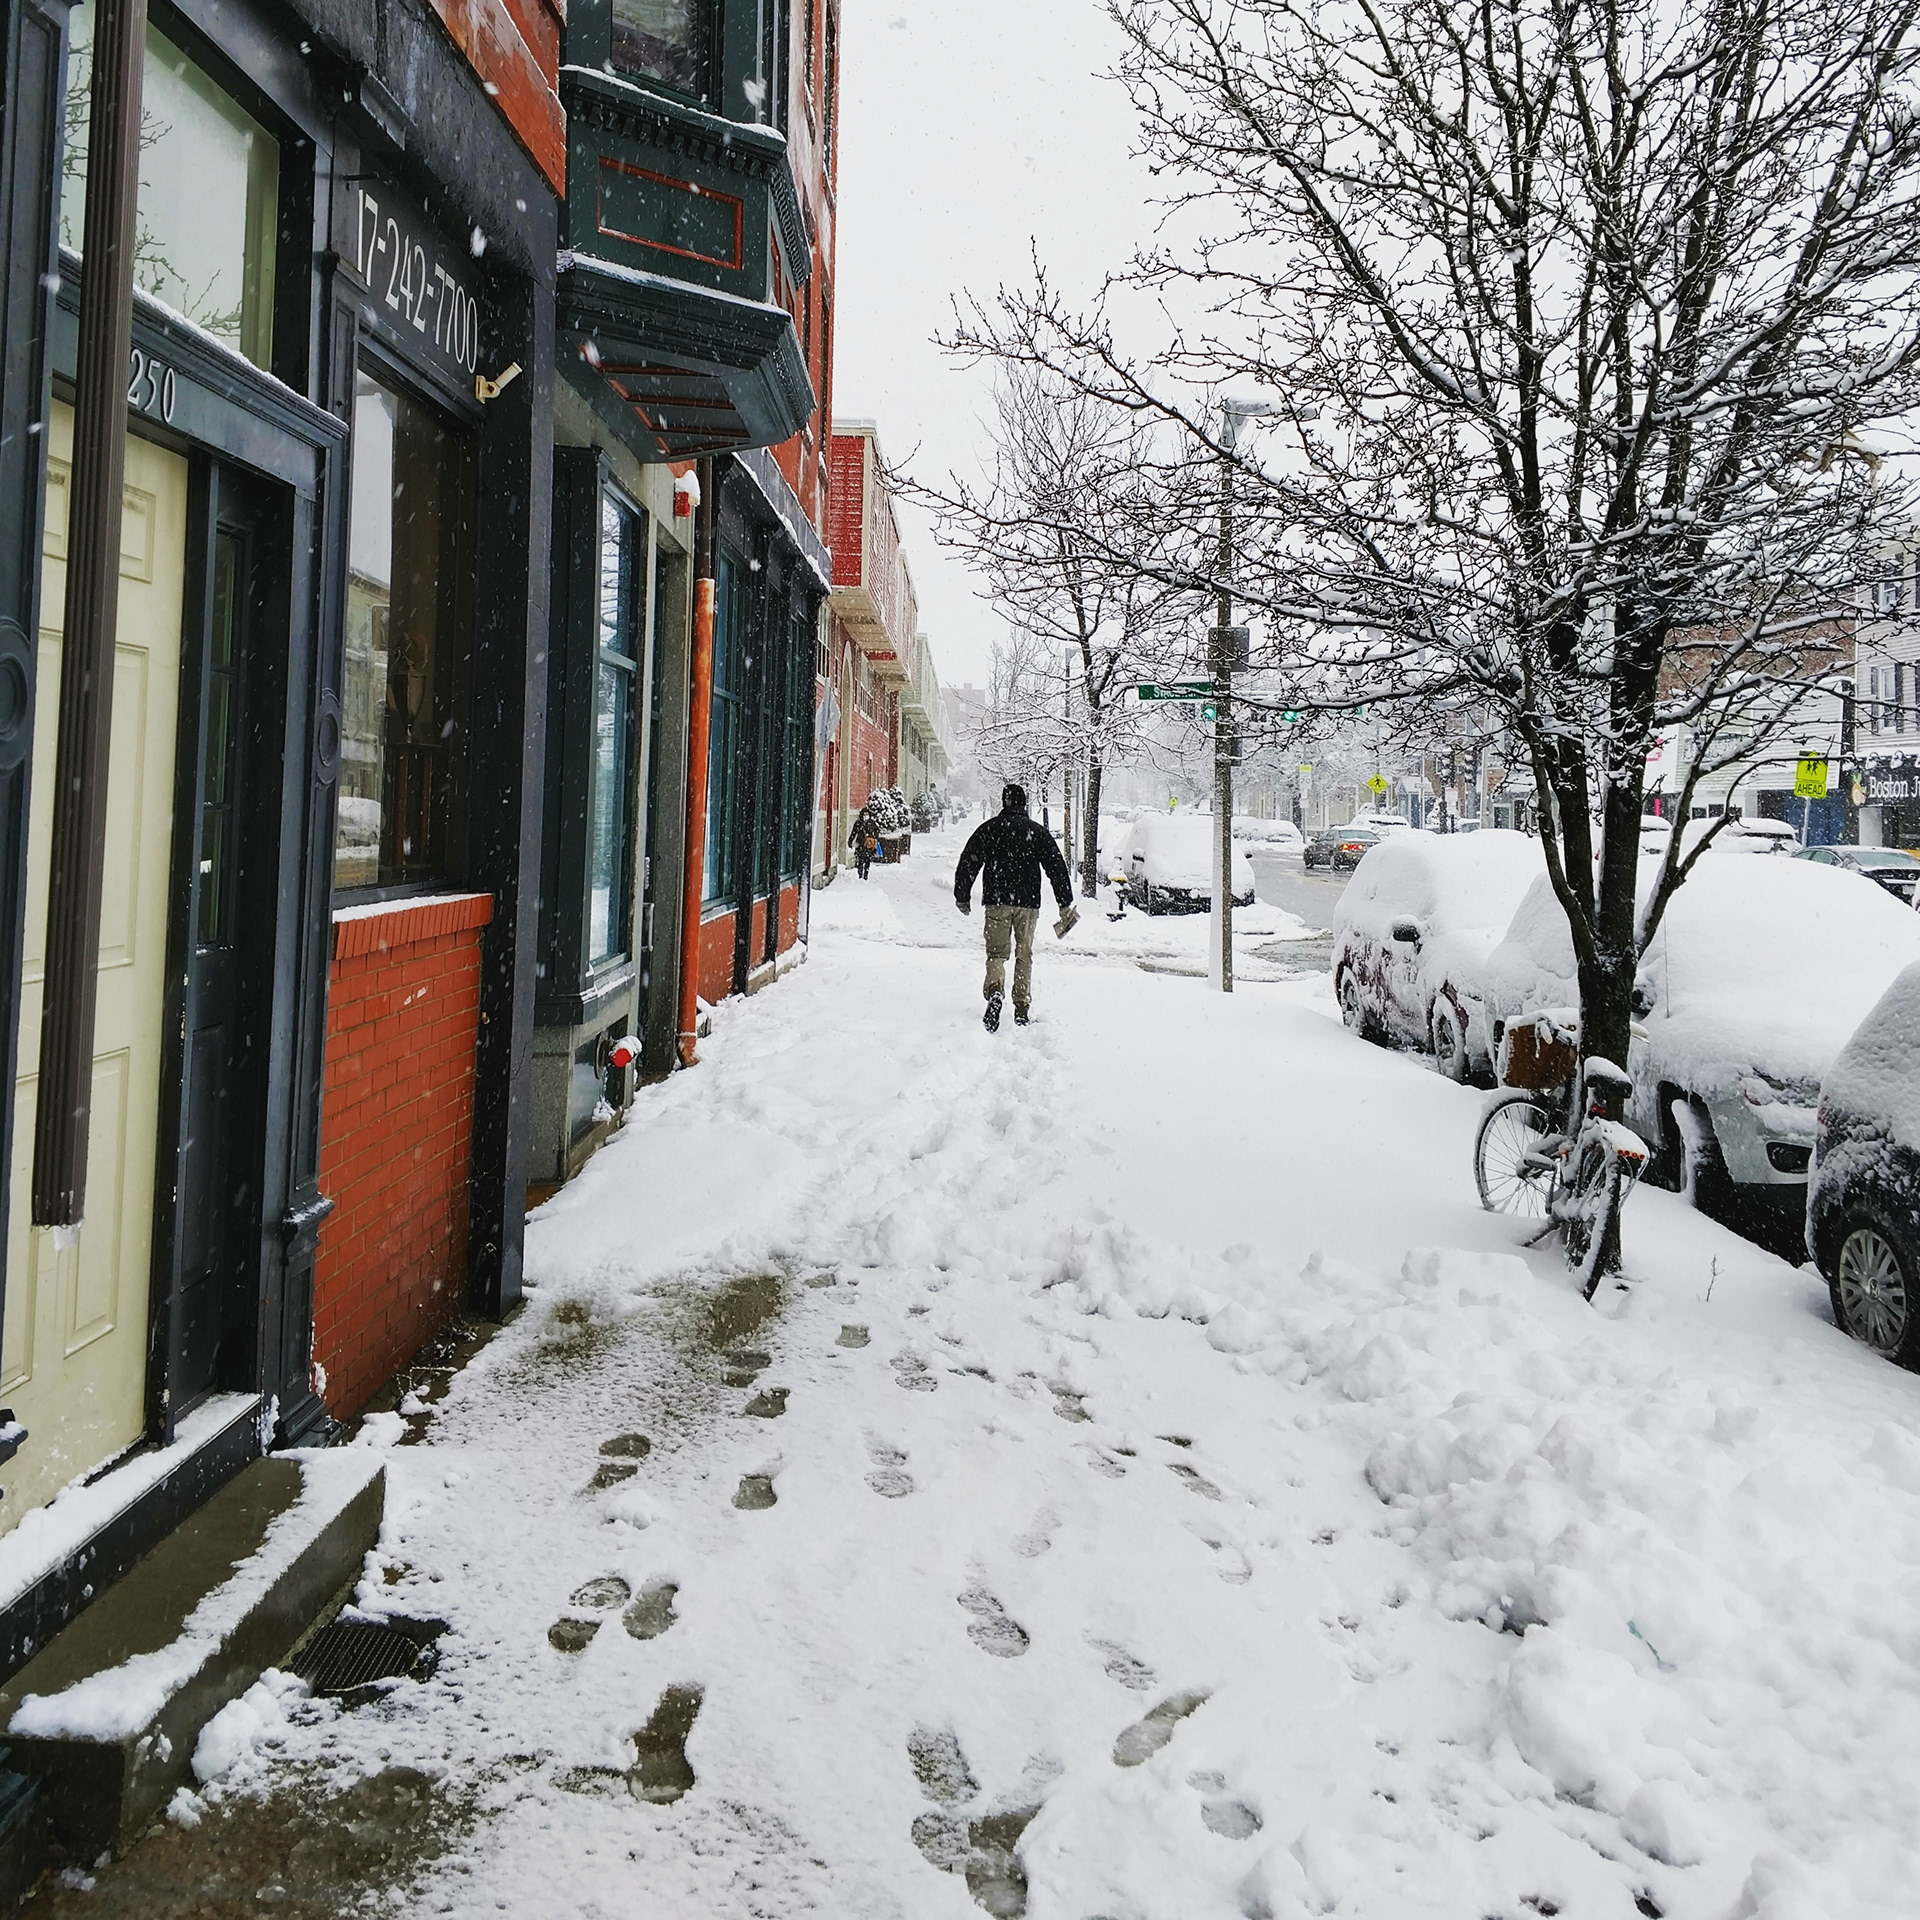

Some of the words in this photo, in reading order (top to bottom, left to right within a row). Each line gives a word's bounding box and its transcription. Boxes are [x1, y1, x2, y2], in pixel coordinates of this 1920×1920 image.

[127, 348, 176, 423] 250
[1796, 783, 1824, 796] AHEAD
[1868, 774, 1910, 799] Boston
